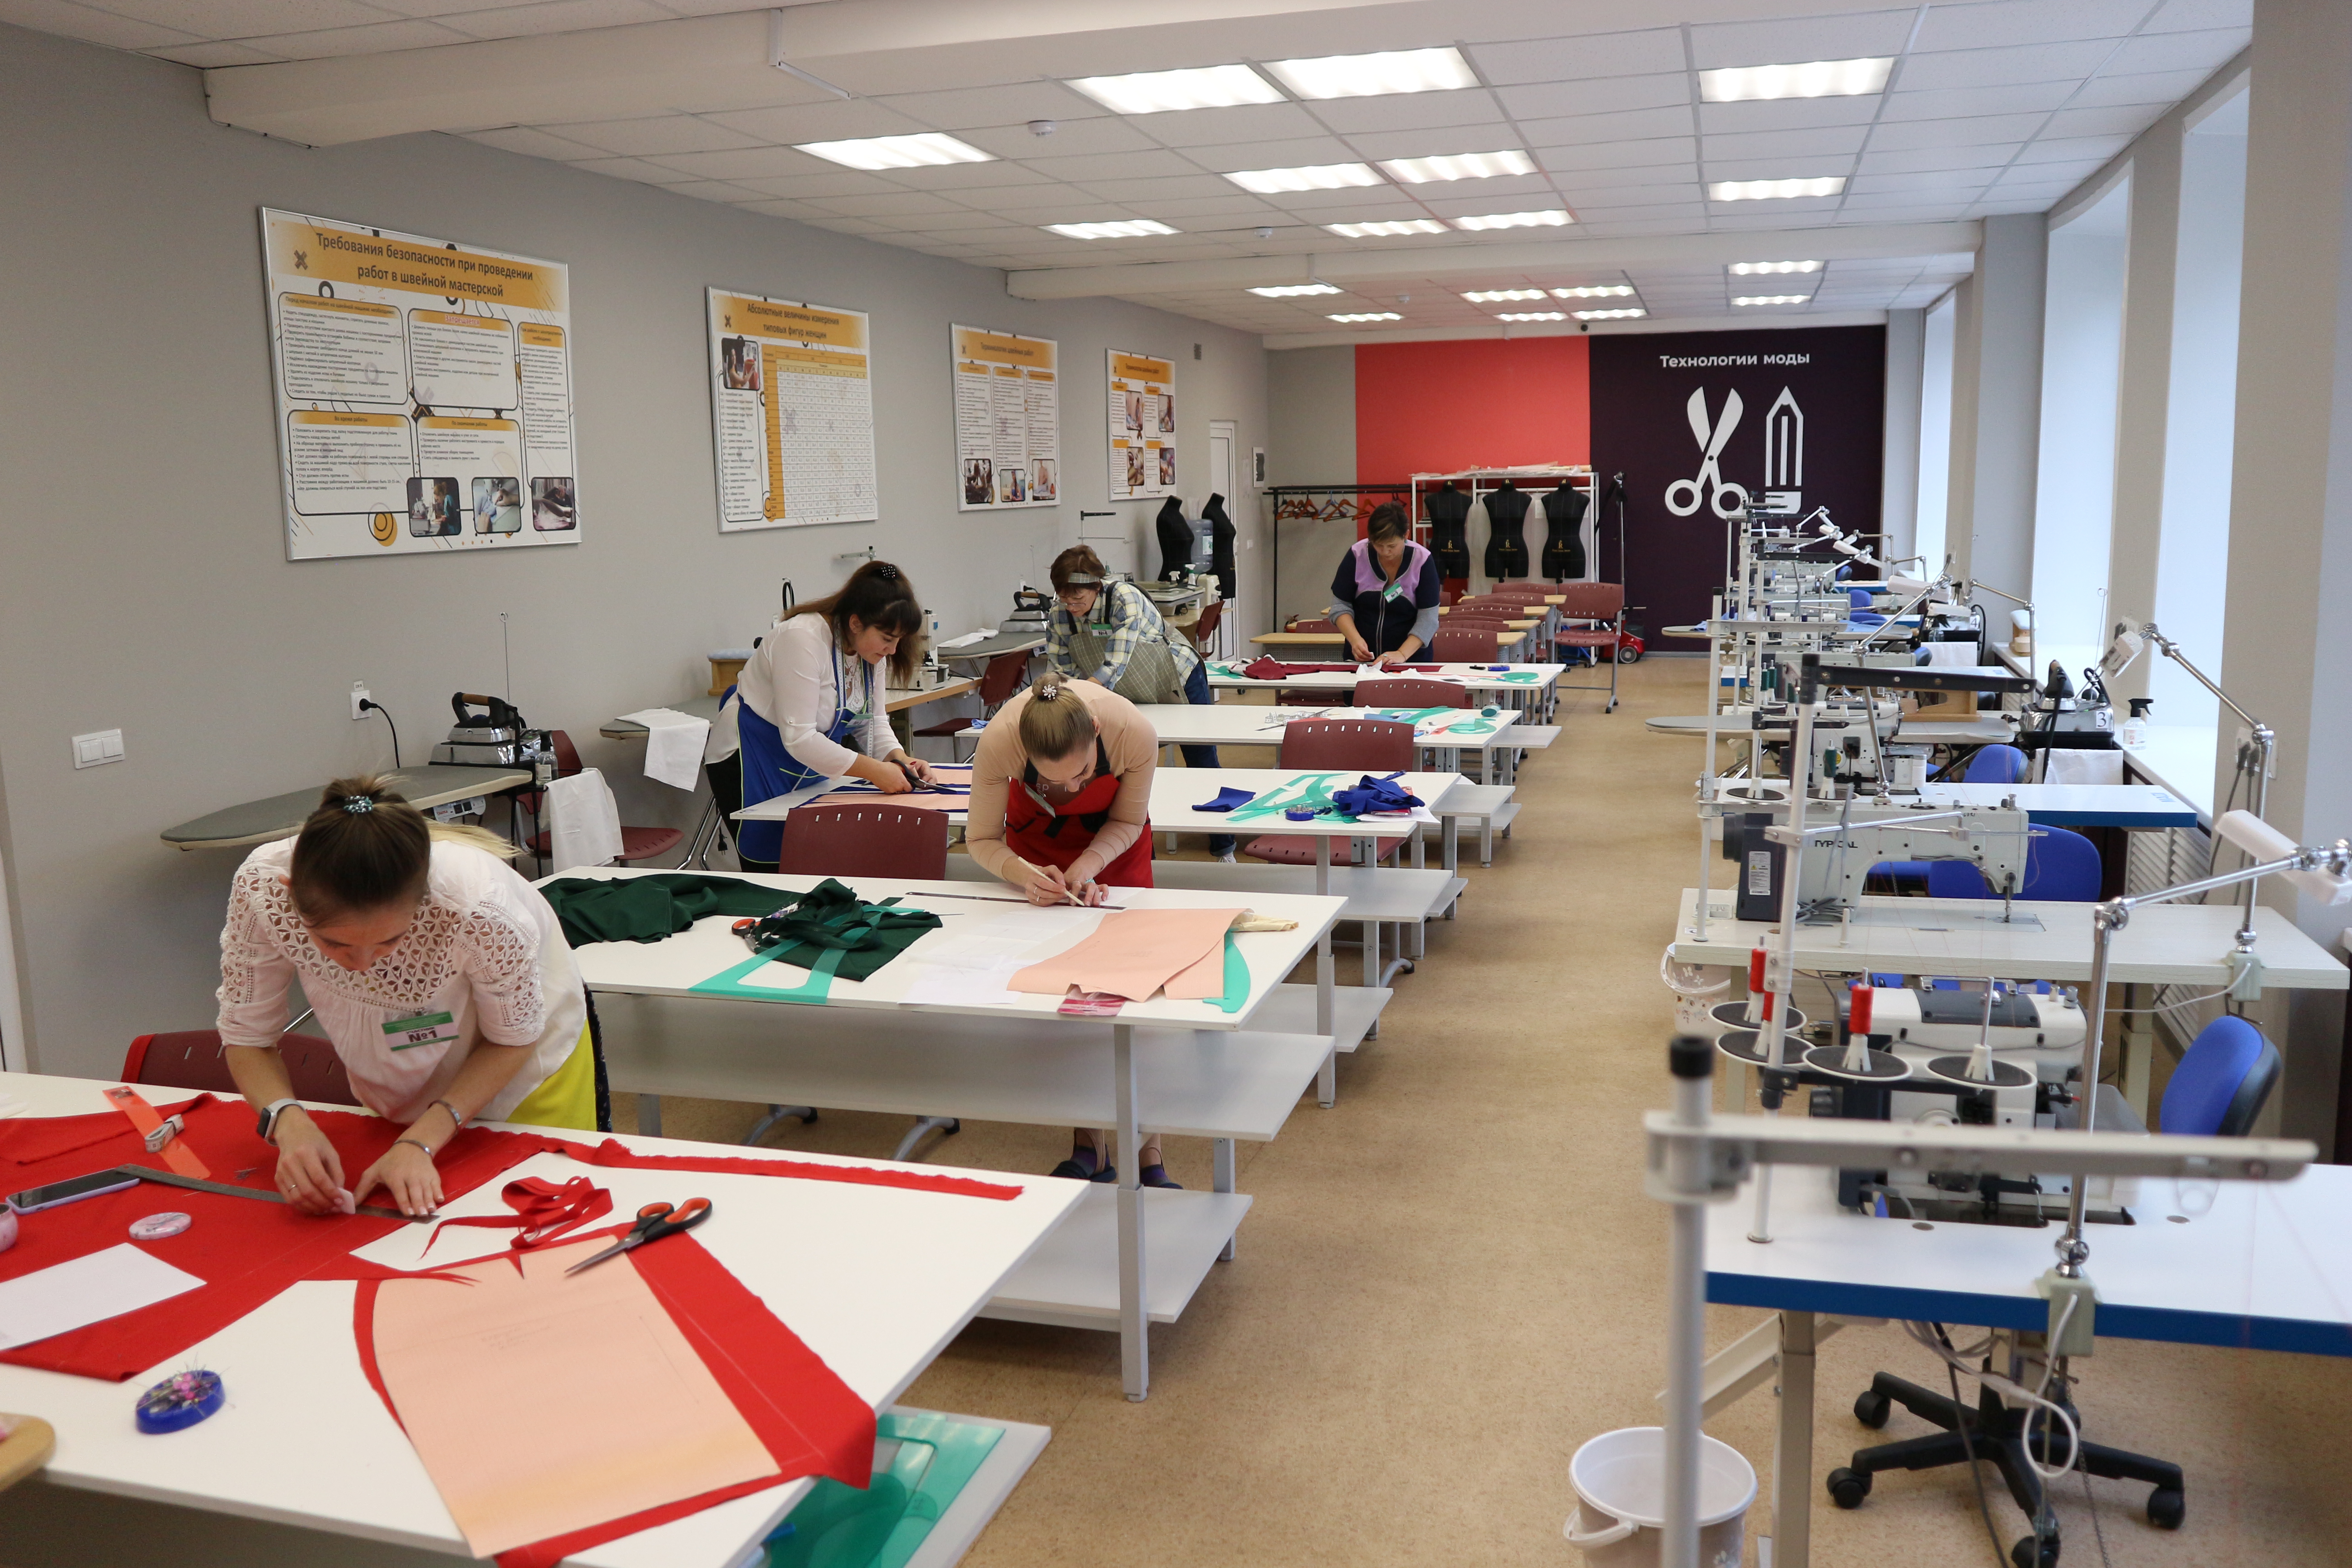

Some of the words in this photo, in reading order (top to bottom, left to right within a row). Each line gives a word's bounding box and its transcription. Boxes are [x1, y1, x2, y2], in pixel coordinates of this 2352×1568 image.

[316, 233, 383, 256] Требования
[387, 245, 455, 268] безопасности
[458, 260, 475, 272] при
[478, 263, 533, 280] проведении
[358, 265, 388, 280] работ
[392, 273, 397, 281] в
[400, 273, 446, 289] швейной
[449, 280, 503, 297] мастерской
[445, 315, 480, 326] Запрещается
[747, 304, 783, 317] Абсолютные
[784, 310, 810, 321] величины
[812, 315, 839, 325] измерения
[763, 324, 787, 334] типовых
[788, 325, 804, 338] фигур
[805, 330, 826, 339] женщин
[1660, 355, 1758, 368] Технологии
[1763, 353, 1810, 366] моды
[1970, 617, 1978, 627] 4
[2097, 712, 2107, 727] 3
[408, 1030, 437, 1043] №1
